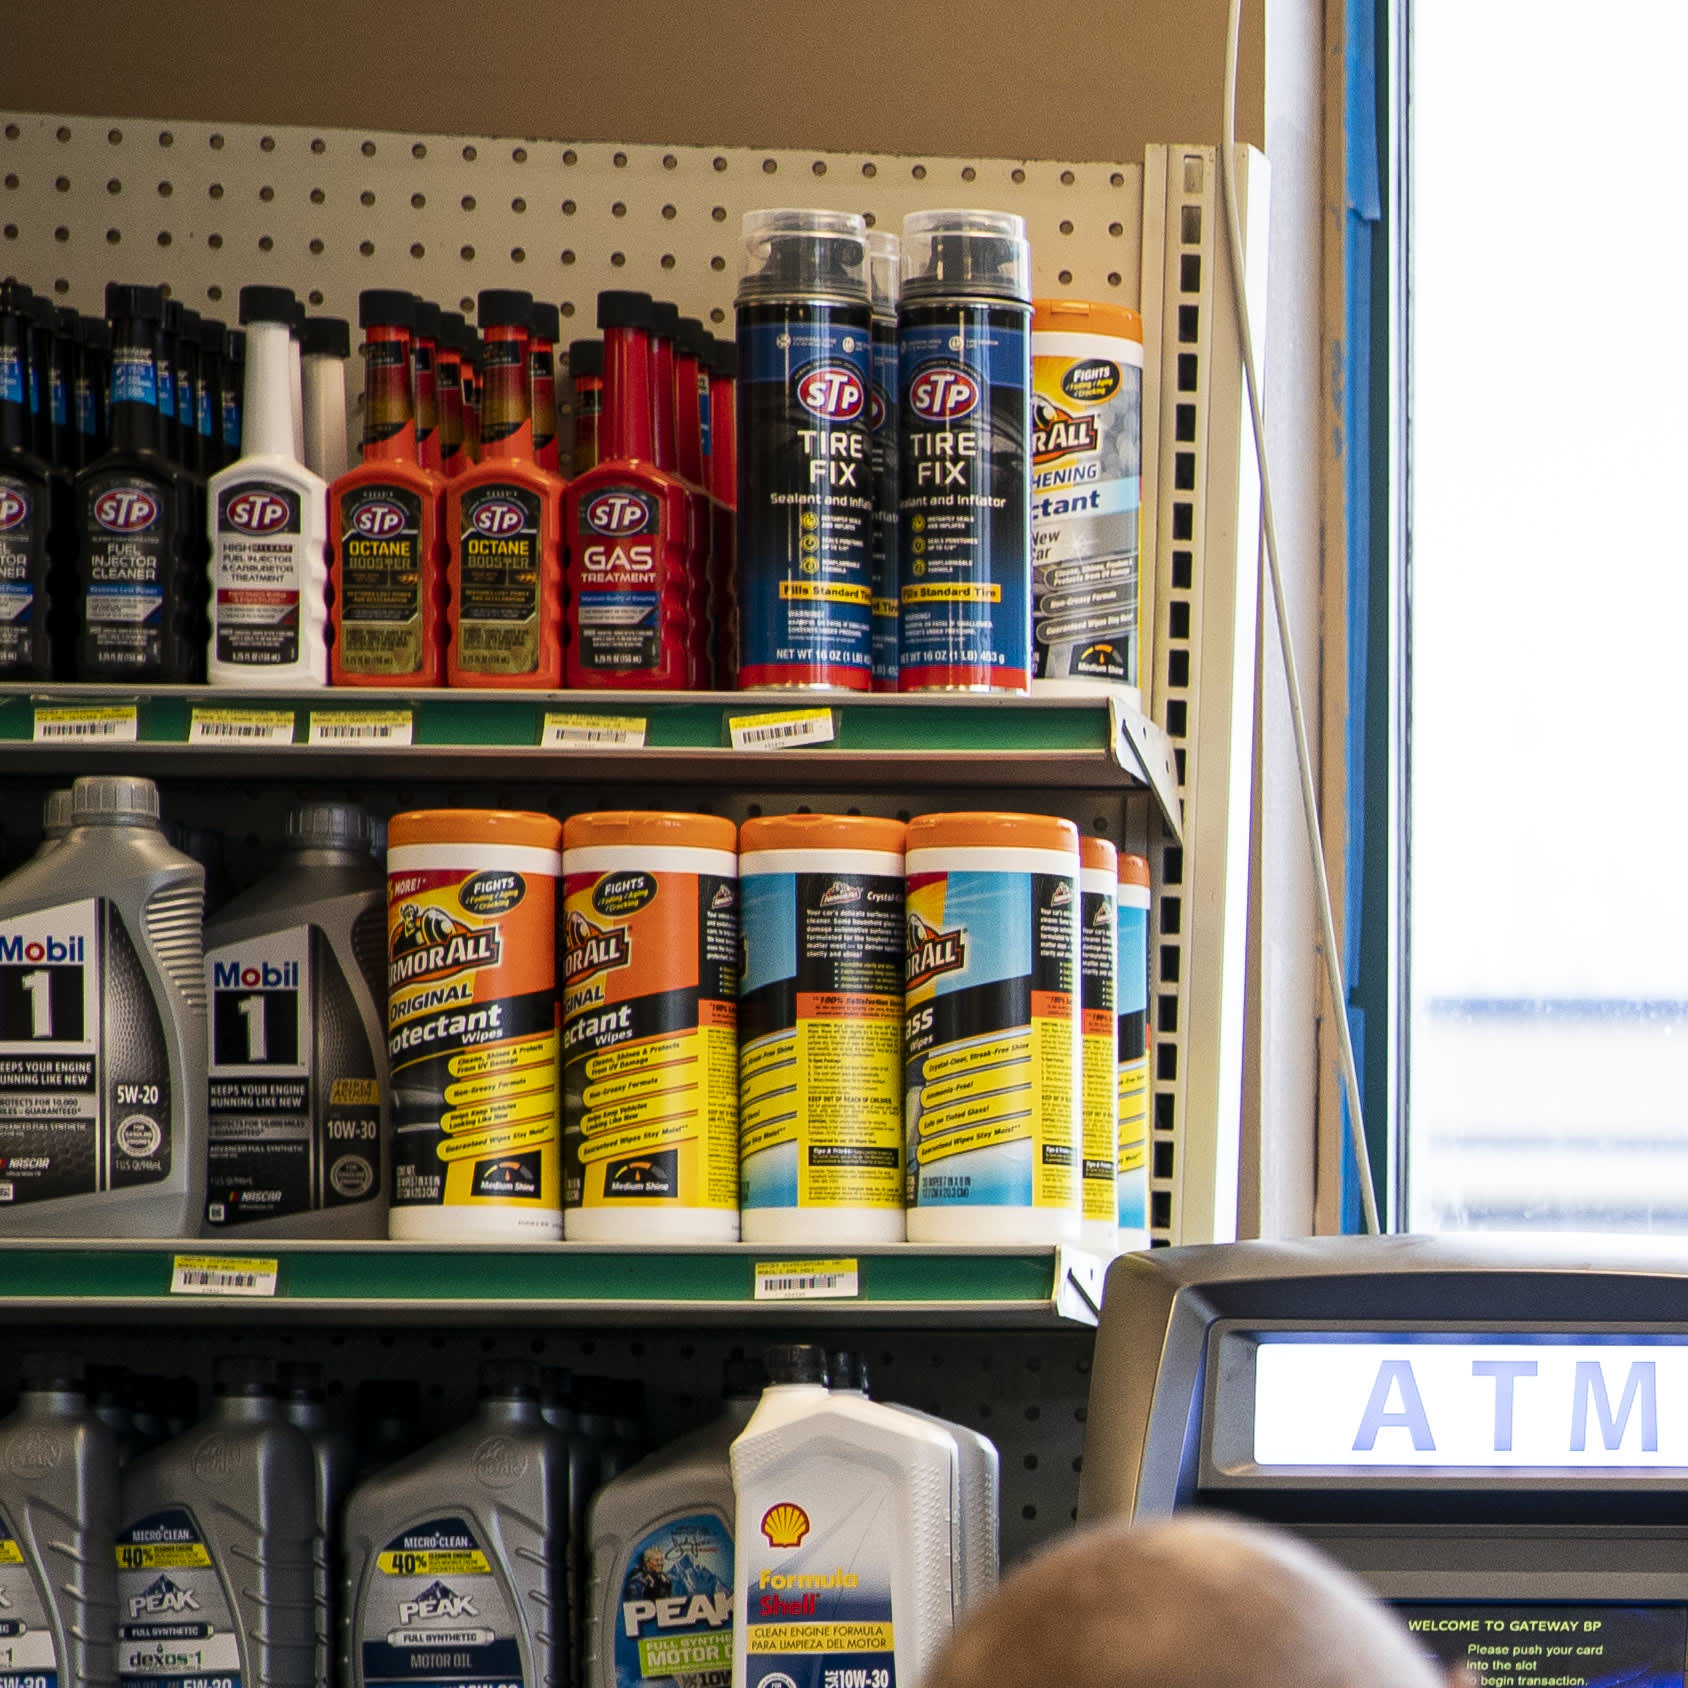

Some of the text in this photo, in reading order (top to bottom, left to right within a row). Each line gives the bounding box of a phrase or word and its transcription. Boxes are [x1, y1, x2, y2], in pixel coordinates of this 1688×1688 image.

[807, 374, 857, 417] STP
[917, 374, 969, 414] STP
[910, 433, 976, 457] TIRE
[918, 461, 966, 486] FIX
[234, 496, 282, 528] STP
[594, 499, 641, 529] STP
[350, 541, 410, 556] OCTANE
[584, 547, 652, 571] GAS
[581, 573, 656, 583] TREATMENT
[474, 878, 515, 894] FIGHTS
[214, 962, 298, 987] Mobil
[238, 995, 266, 1061] 1
[463, 1029, 503, 1044] Wipes
[117, 1085, 158, 1104] 5W-20
[328, 1121, 376, 1139] 10W-30
[1352, 1360, 1658, 1452] ATM
[760, 1569, 858, 1590] Formula
[400, 1595, 479, 1625] PEAK
[760, 1595, 815, 1616] Shell
[755, 1626, 883, 1637] CLEAN ENGINE FORMULA
[1408, 1620, 1601, 1631] WELCOME TO GATEWAY BP
[1468, 1645, 1603, 1658] Please push your card
